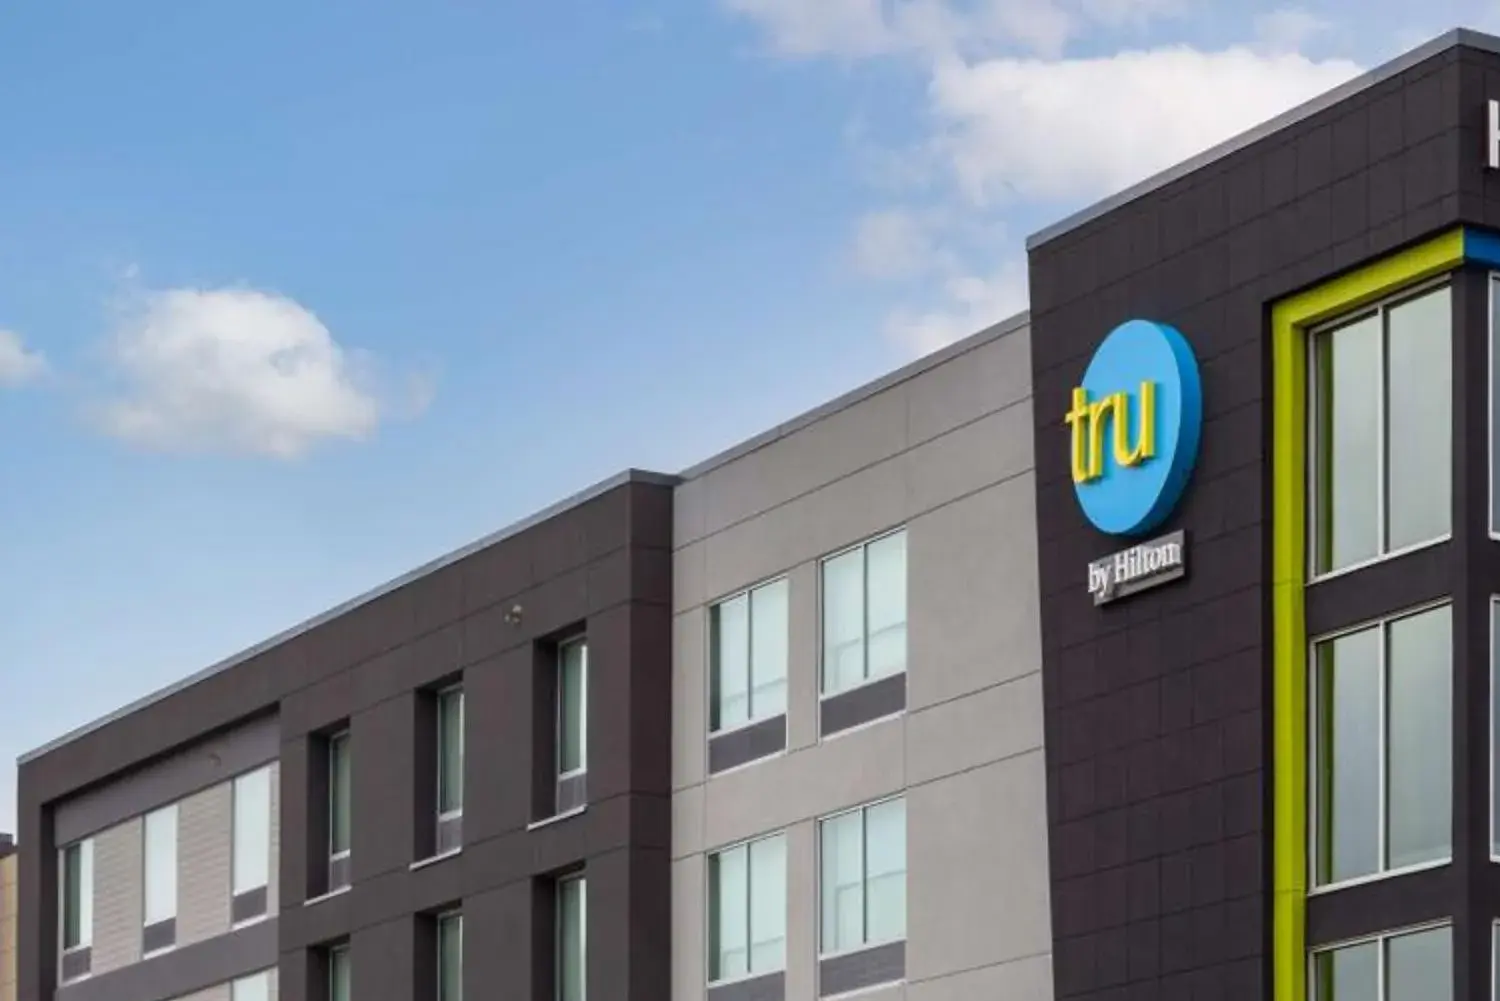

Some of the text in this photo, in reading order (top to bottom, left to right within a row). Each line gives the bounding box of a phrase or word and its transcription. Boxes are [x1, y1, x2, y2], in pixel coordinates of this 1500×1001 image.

[1064, 378, 1155, 483] tru
[1087, 543, 1182, 598] by Hilton
